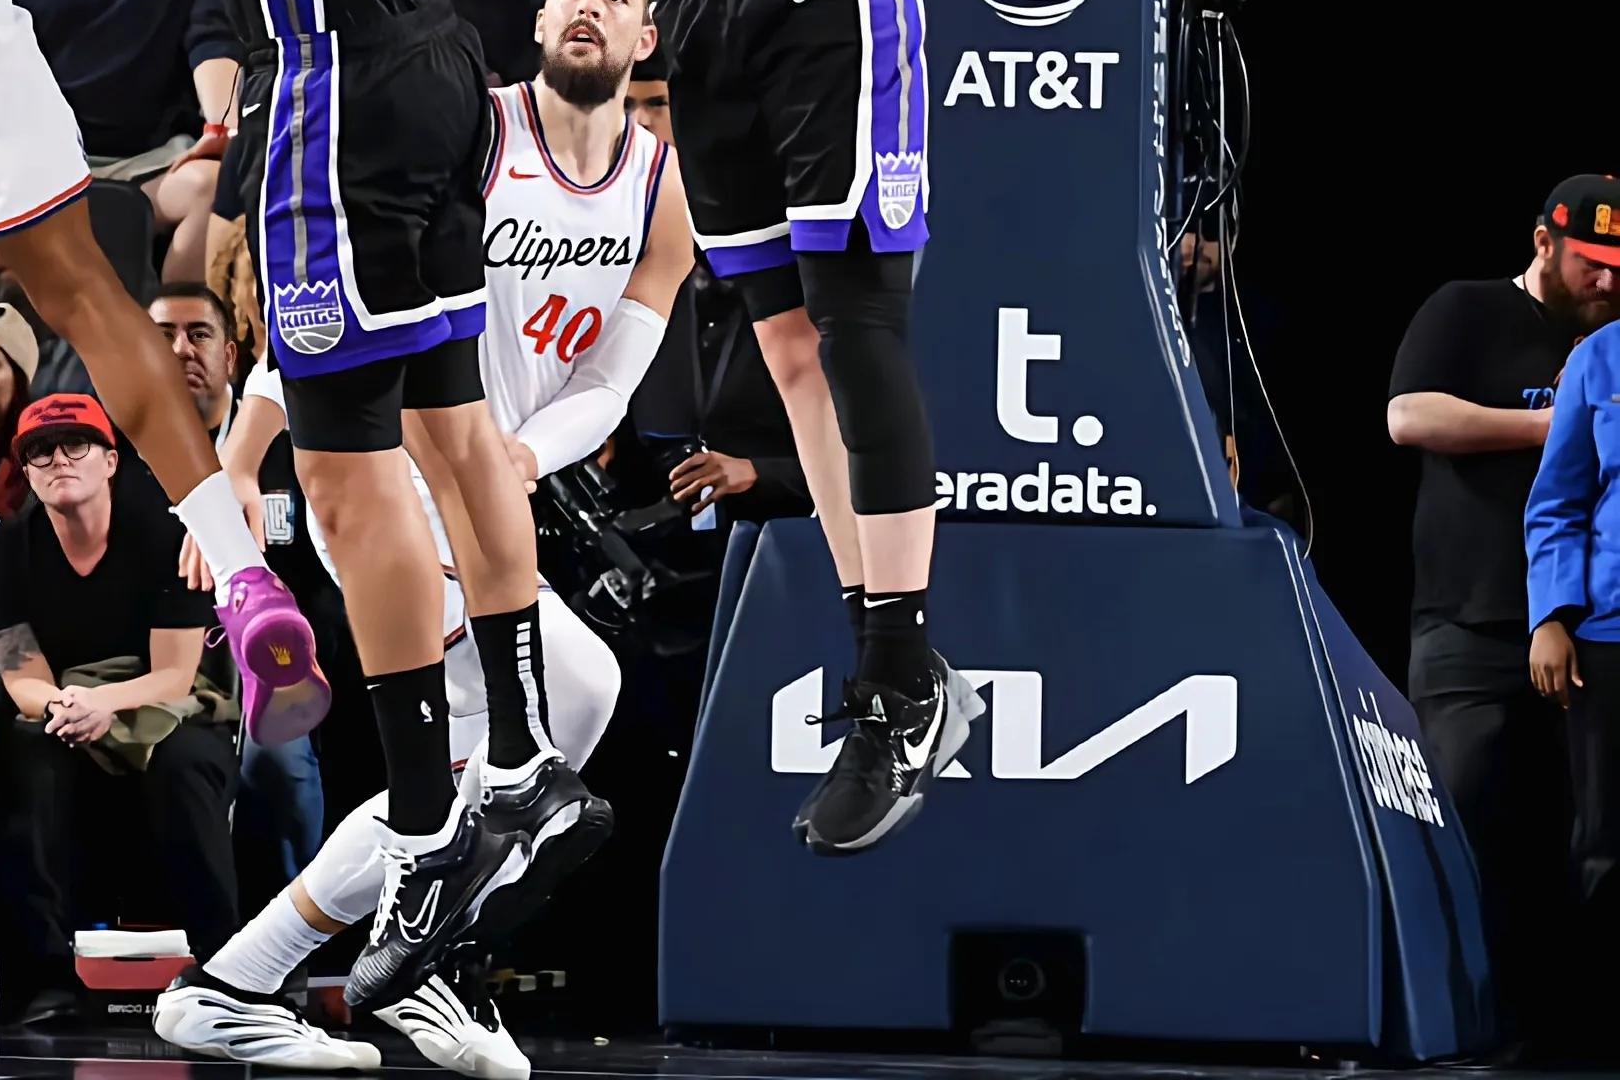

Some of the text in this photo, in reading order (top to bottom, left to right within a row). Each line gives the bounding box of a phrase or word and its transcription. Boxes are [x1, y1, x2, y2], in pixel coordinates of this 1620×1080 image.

[942, 49, 1121, 111] AT&T
[482, 217, 634, 281] Clippers
[279, 308, 343, 330] KINGS
[522, 293, 604, 365] 40
[934, 461, 1158, 518] eradata.
